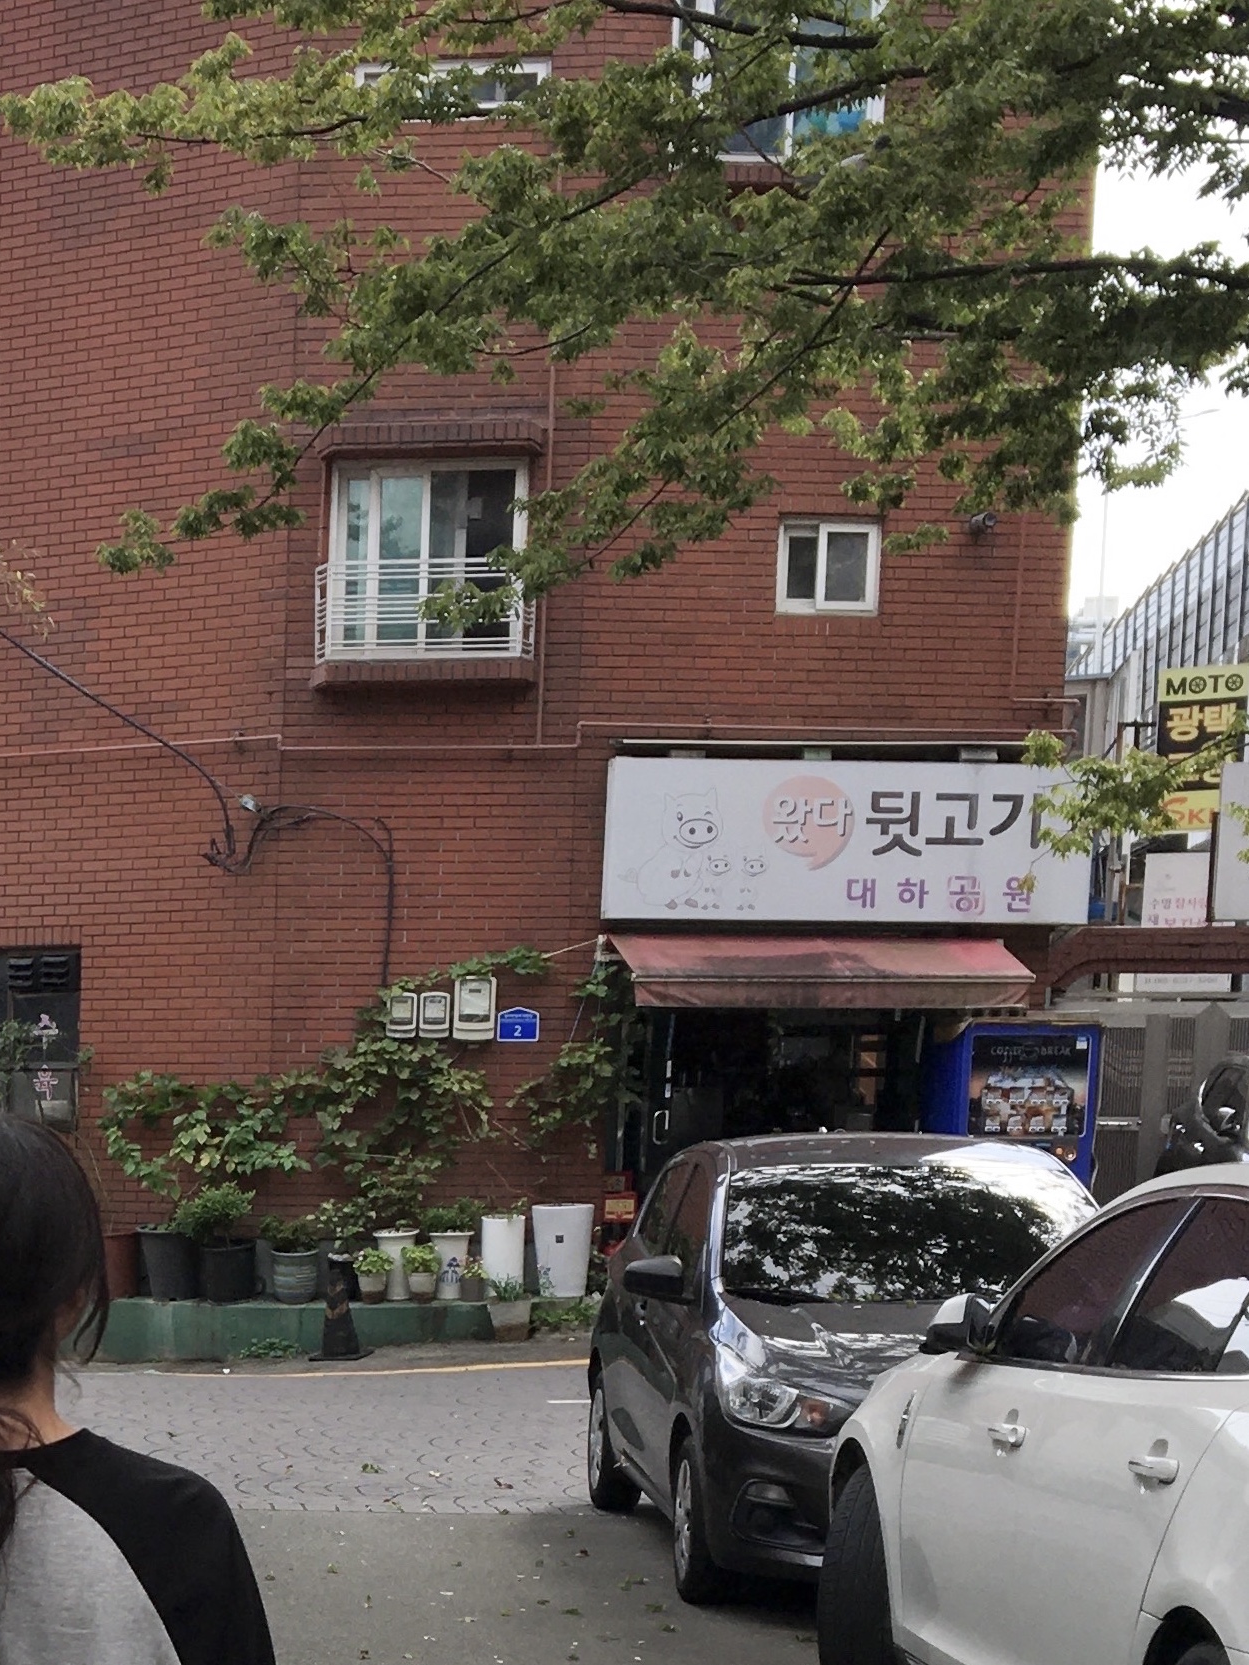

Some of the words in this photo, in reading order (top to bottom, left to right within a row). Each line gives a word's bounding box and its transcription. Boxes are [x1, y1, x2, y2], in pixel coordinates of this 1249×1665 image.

[1166, 673, 1244, 696] MOTO
[773, 797, 852, 843] 왔다
[866, 791, 1044, 857] 뒷고기
[514, 1025, 522, 1037] 2
